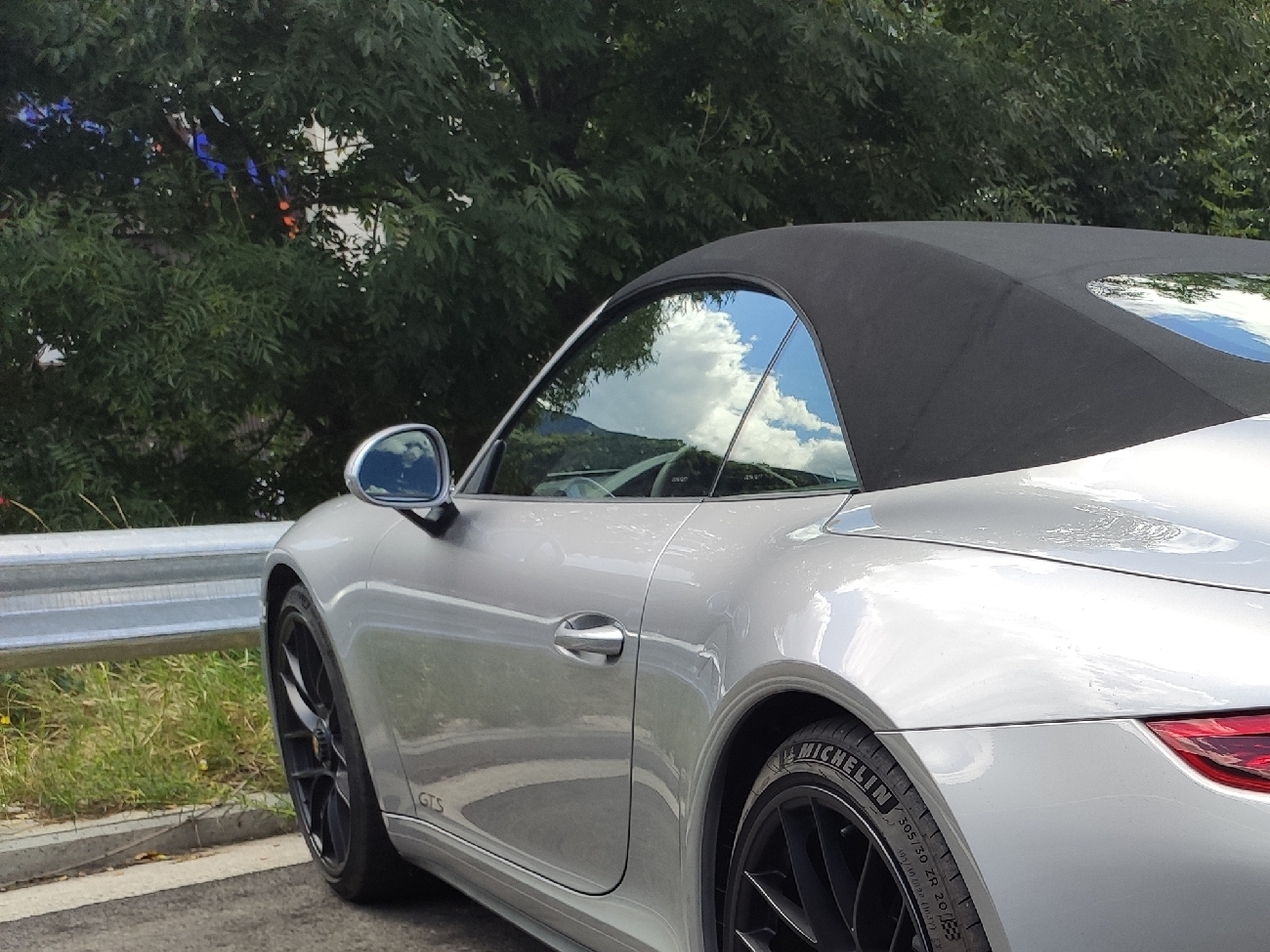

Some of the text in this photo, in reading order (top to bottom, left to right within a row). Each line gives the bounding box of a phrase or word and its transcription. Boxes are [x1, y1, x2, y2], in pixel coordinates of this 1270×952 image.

[418, 791, 444, 813] GTS
[798, 742, 893, 806] MICHELIN
[898, 816, 948, 911] 305/30 ZR 20
